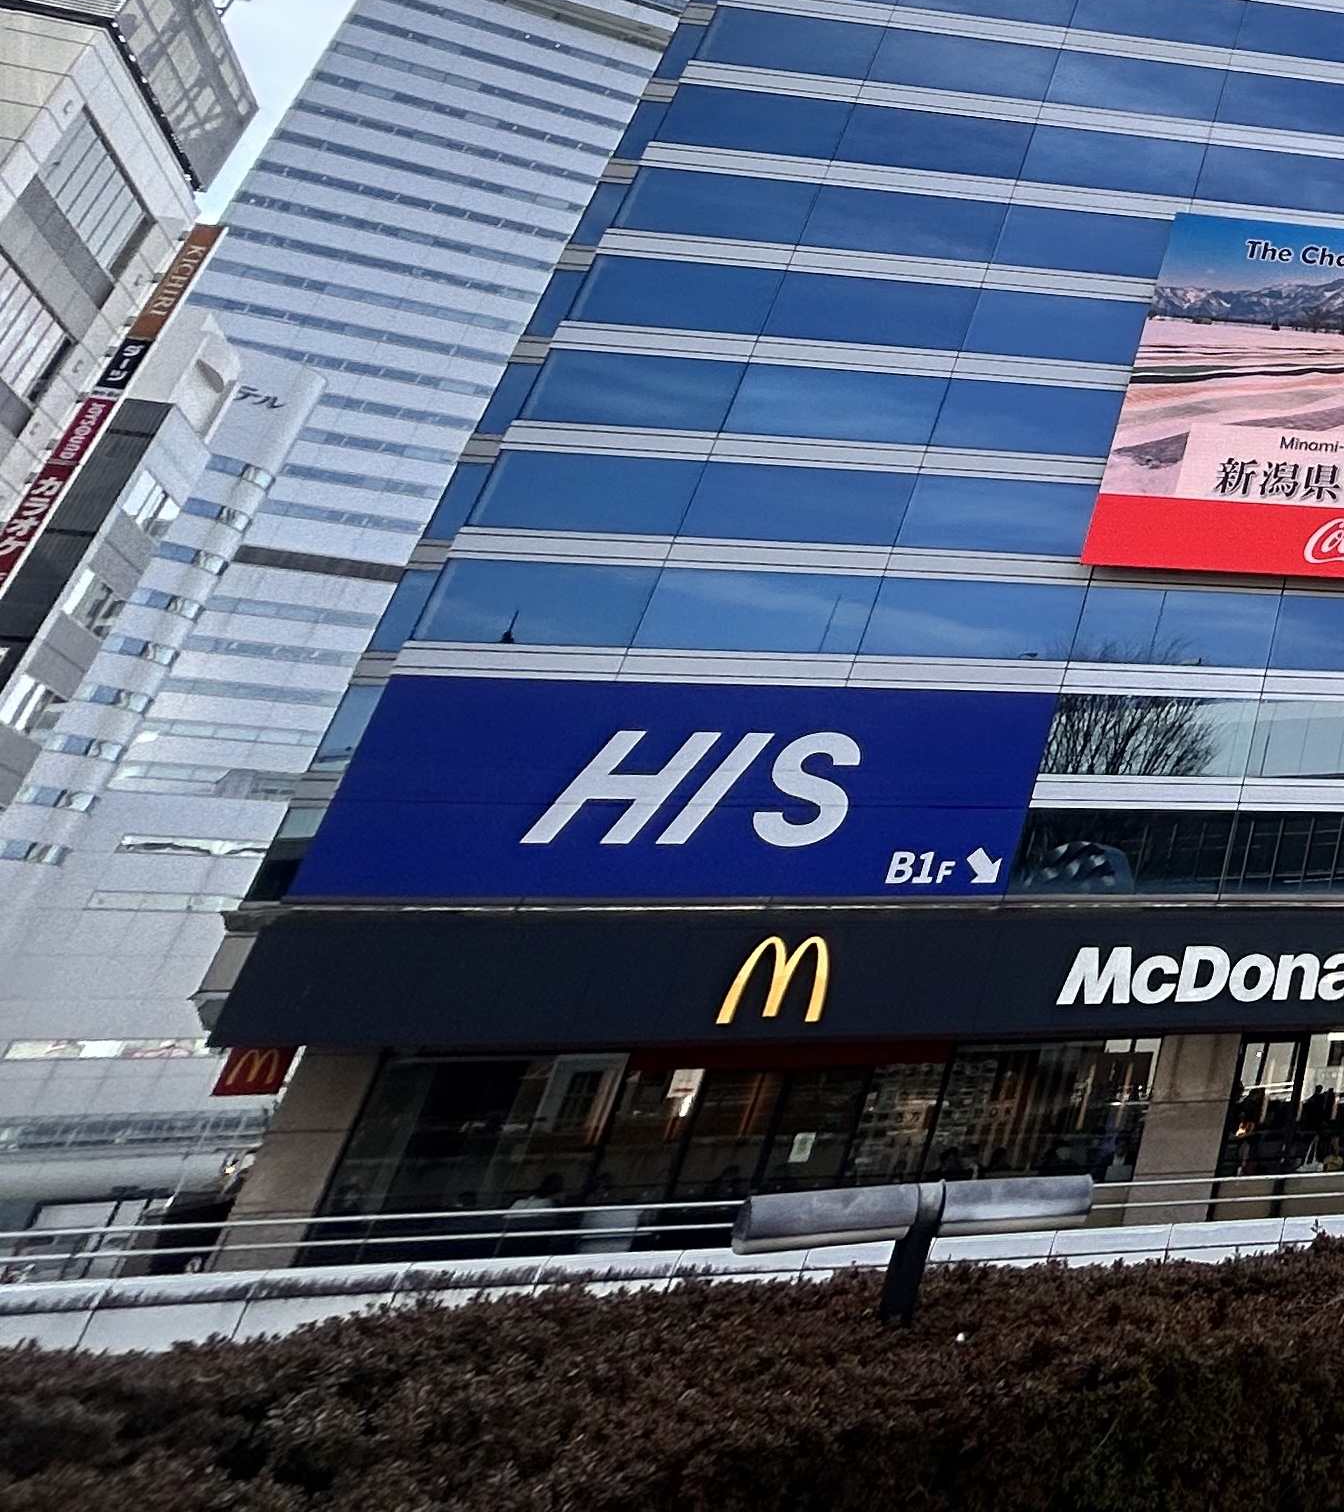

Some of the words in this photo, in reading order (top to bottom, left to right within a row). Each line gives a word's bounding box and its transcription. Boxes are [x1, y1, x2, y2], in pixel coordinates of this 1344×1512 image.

[1247, 239, 1293, 264] The
[1214, 456, 1340, 502] 新潟県
[884, 850, 957, 885] B1F
